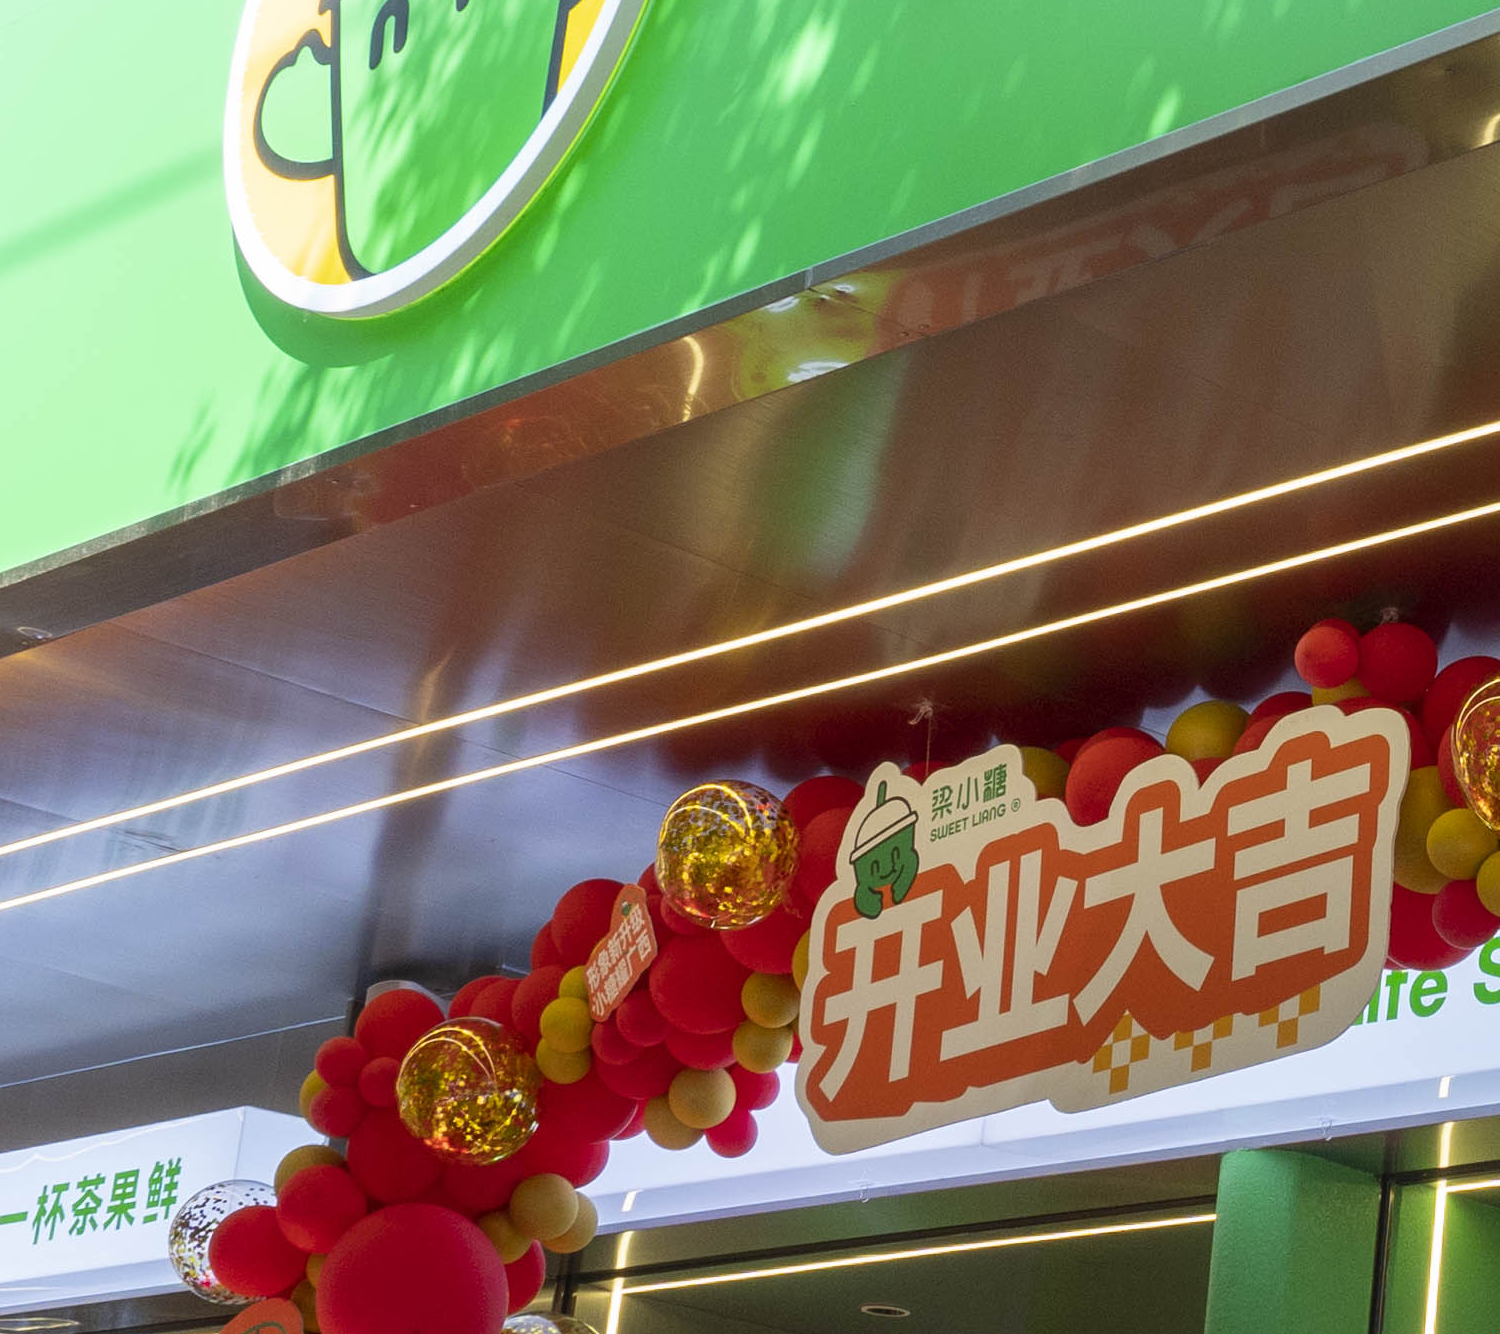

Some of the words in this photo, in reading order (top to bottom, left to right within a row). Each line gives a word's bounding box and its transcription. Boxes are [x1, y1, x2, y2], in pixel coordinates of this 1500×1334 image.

[931, 763, 1007, 822] 梁小糖
[930, 817, 969, 842] SWEET
[972, 803, 1006, 827] LIANG
[816, 759, 1367, 1103] 开业大吉
